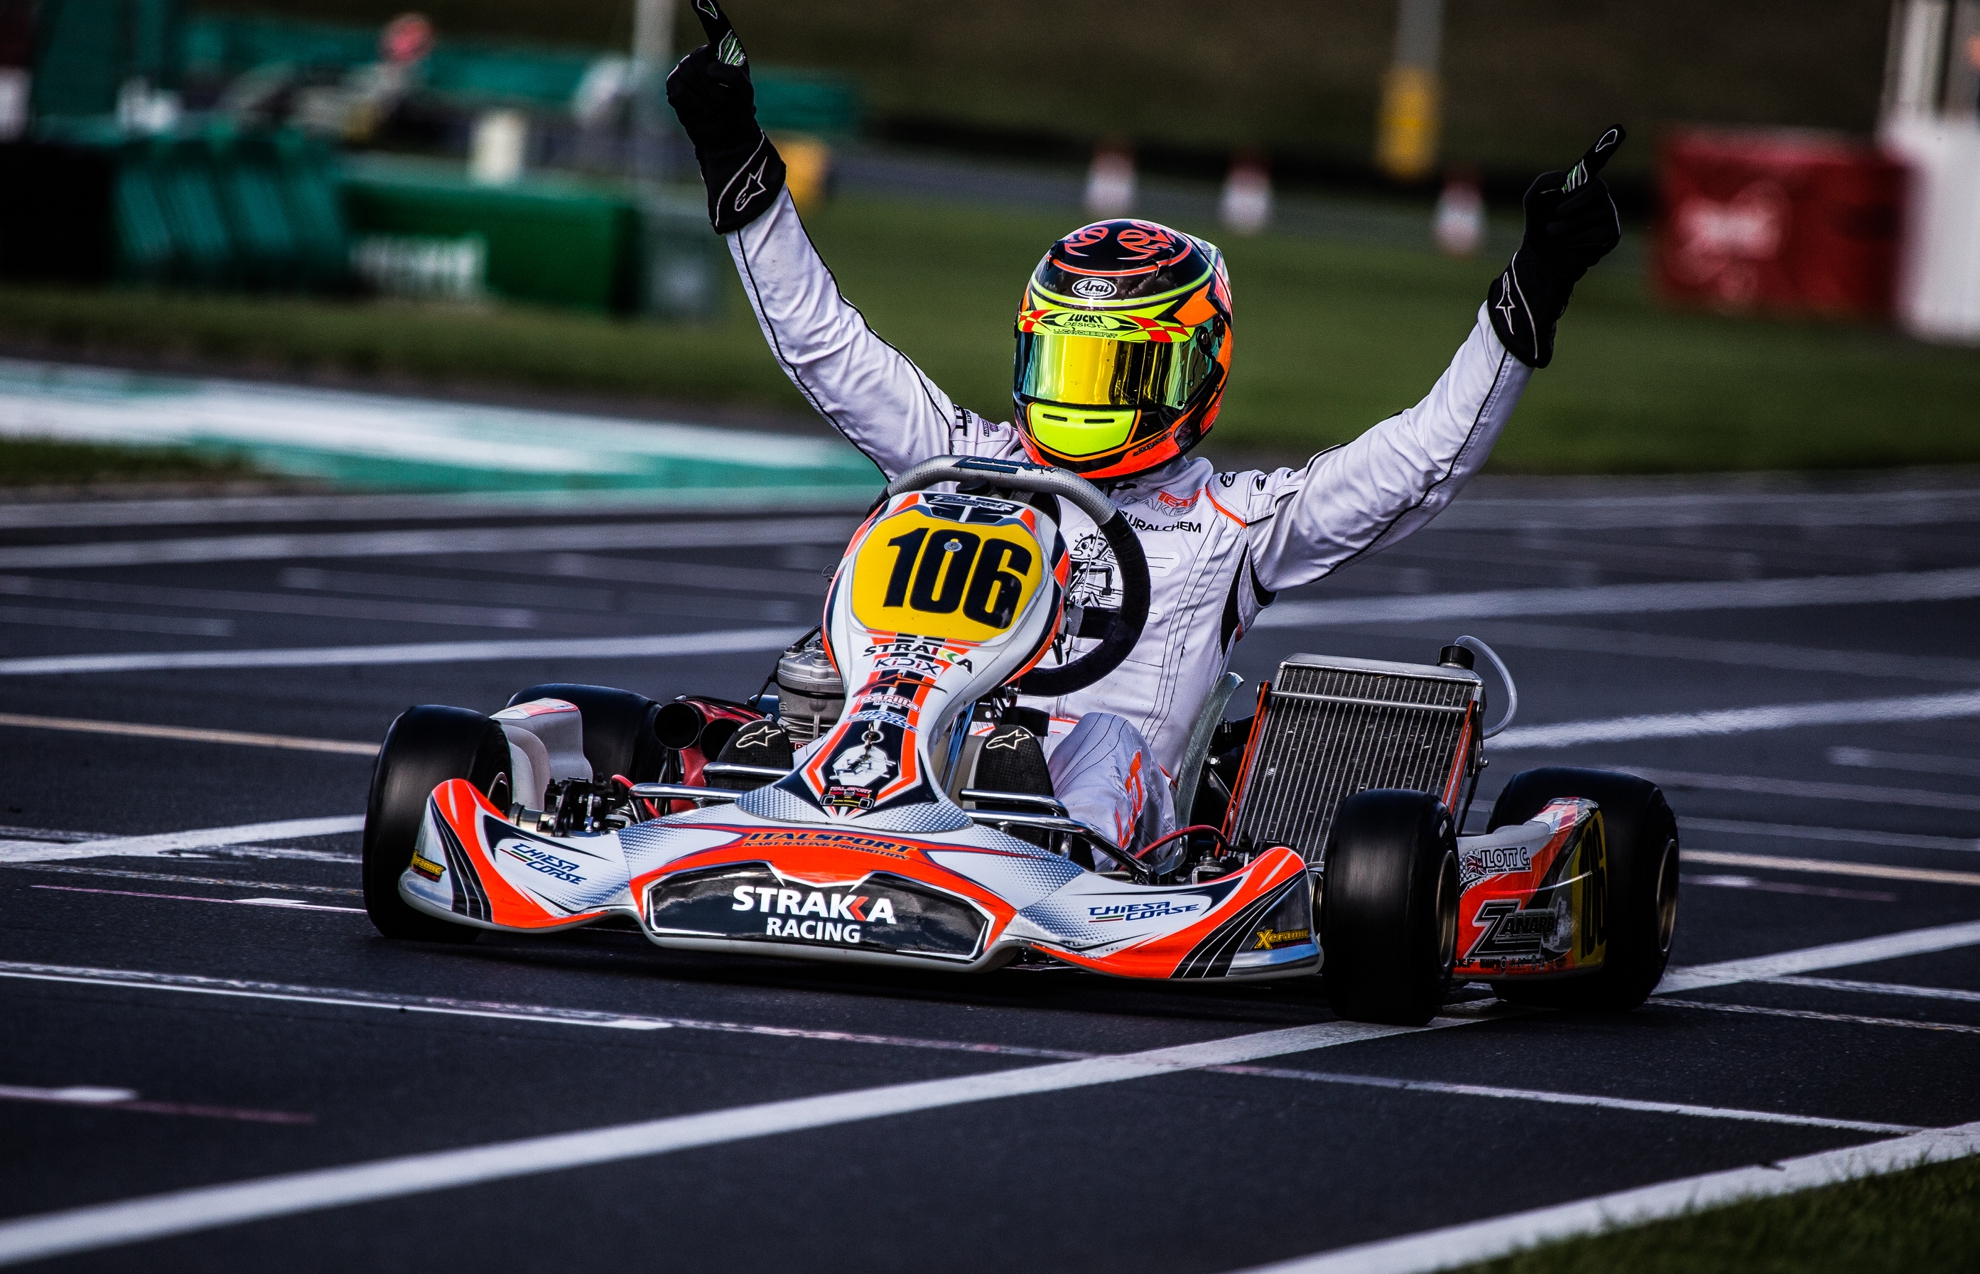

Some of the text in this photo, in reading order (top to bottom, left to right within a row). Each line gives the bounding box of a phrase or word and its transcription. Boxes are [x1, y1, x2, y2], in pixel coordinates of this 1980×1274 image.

[1079, 280, 1111, 293] Arai
[1063, 322, 1108, 330] DESIGN
[1068, 313, 1105, 324] LUCKY
[1127, 513, 1202, 533] URALCHEM
[883, 527, 1032, 629] 106
[749, 833, 915, 853] ITALSPORT
[833, 843, 909, 860] PROMOTION
[512, 843, 580, 872] CHIESA
[1481, 847, 1518, 868] ILOTT
[525, 860, 587, 885] CORSE
[732, 885, 897, 925] STRAKKA
[1087, 901, 1171, 917] CHIESA
[1125, 903, 1200, 922] CORSE
[766, 917, 862, 944] RACING
